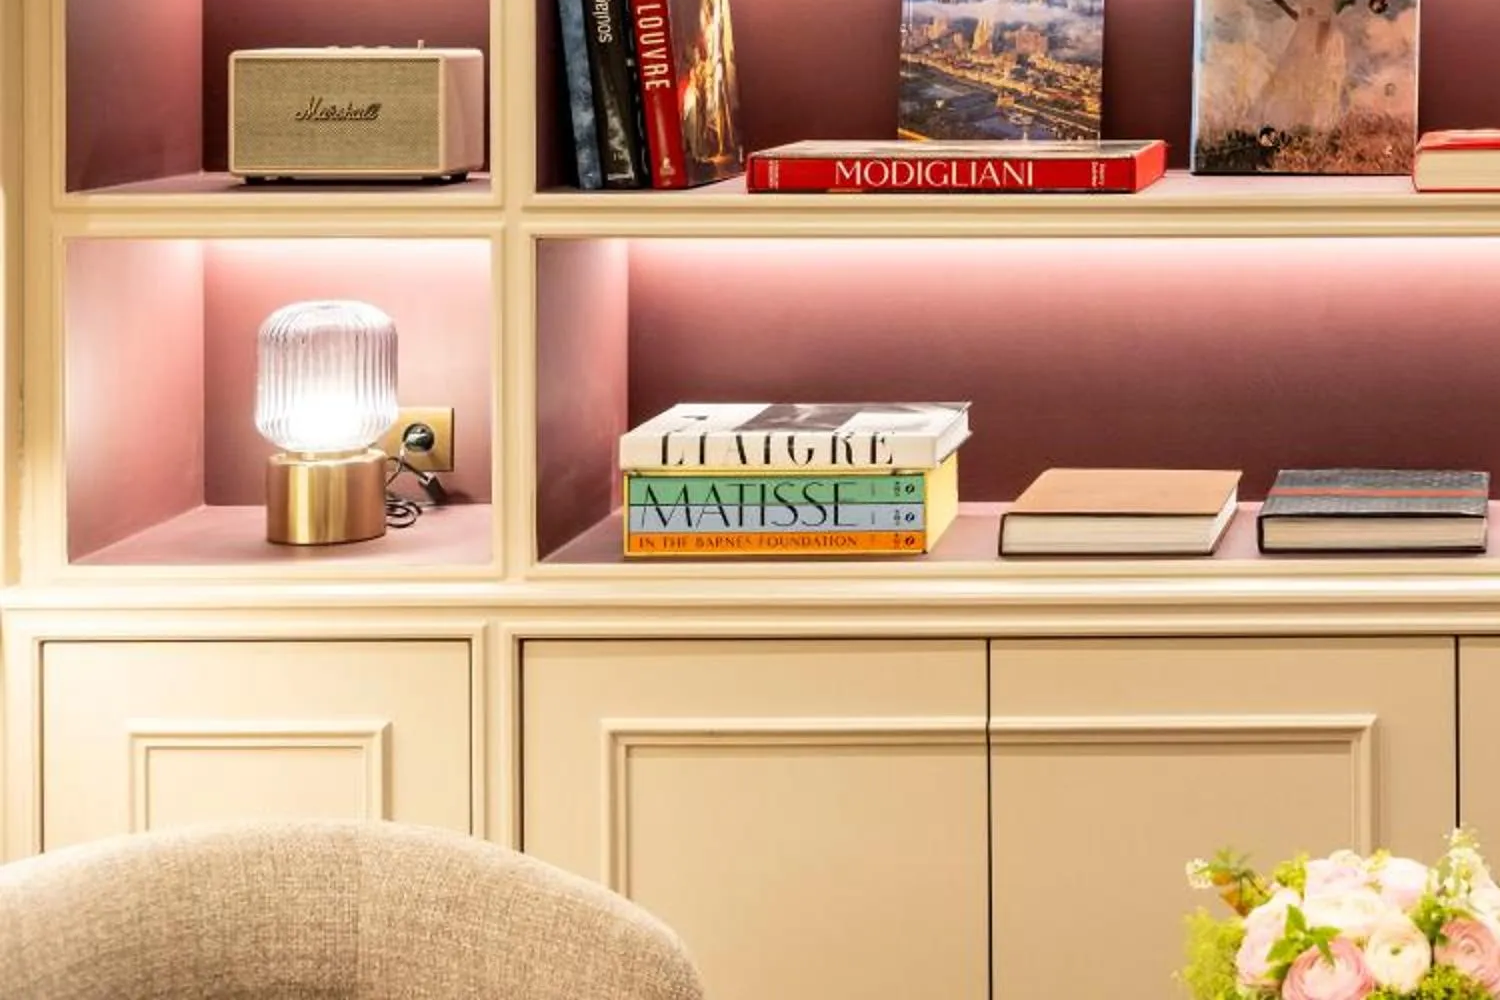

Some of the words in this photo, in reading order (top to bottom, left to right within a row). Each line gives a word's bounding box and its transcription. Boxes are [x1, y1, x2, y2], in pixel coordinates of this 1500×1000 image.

[637, 3, 670, 89] LOUVRE
[295, 96, 382, 121] Marshall
[834, 160, 1033, 187] MODIGLIANI
[641, 481, 860, 529] MATISSE
[639, 535, 655, 548] IN
[662, 535, 688, 548] THE
[695, 534, 752, 548] BARNES
[758, 534, 858, 548] FOUNDATION
